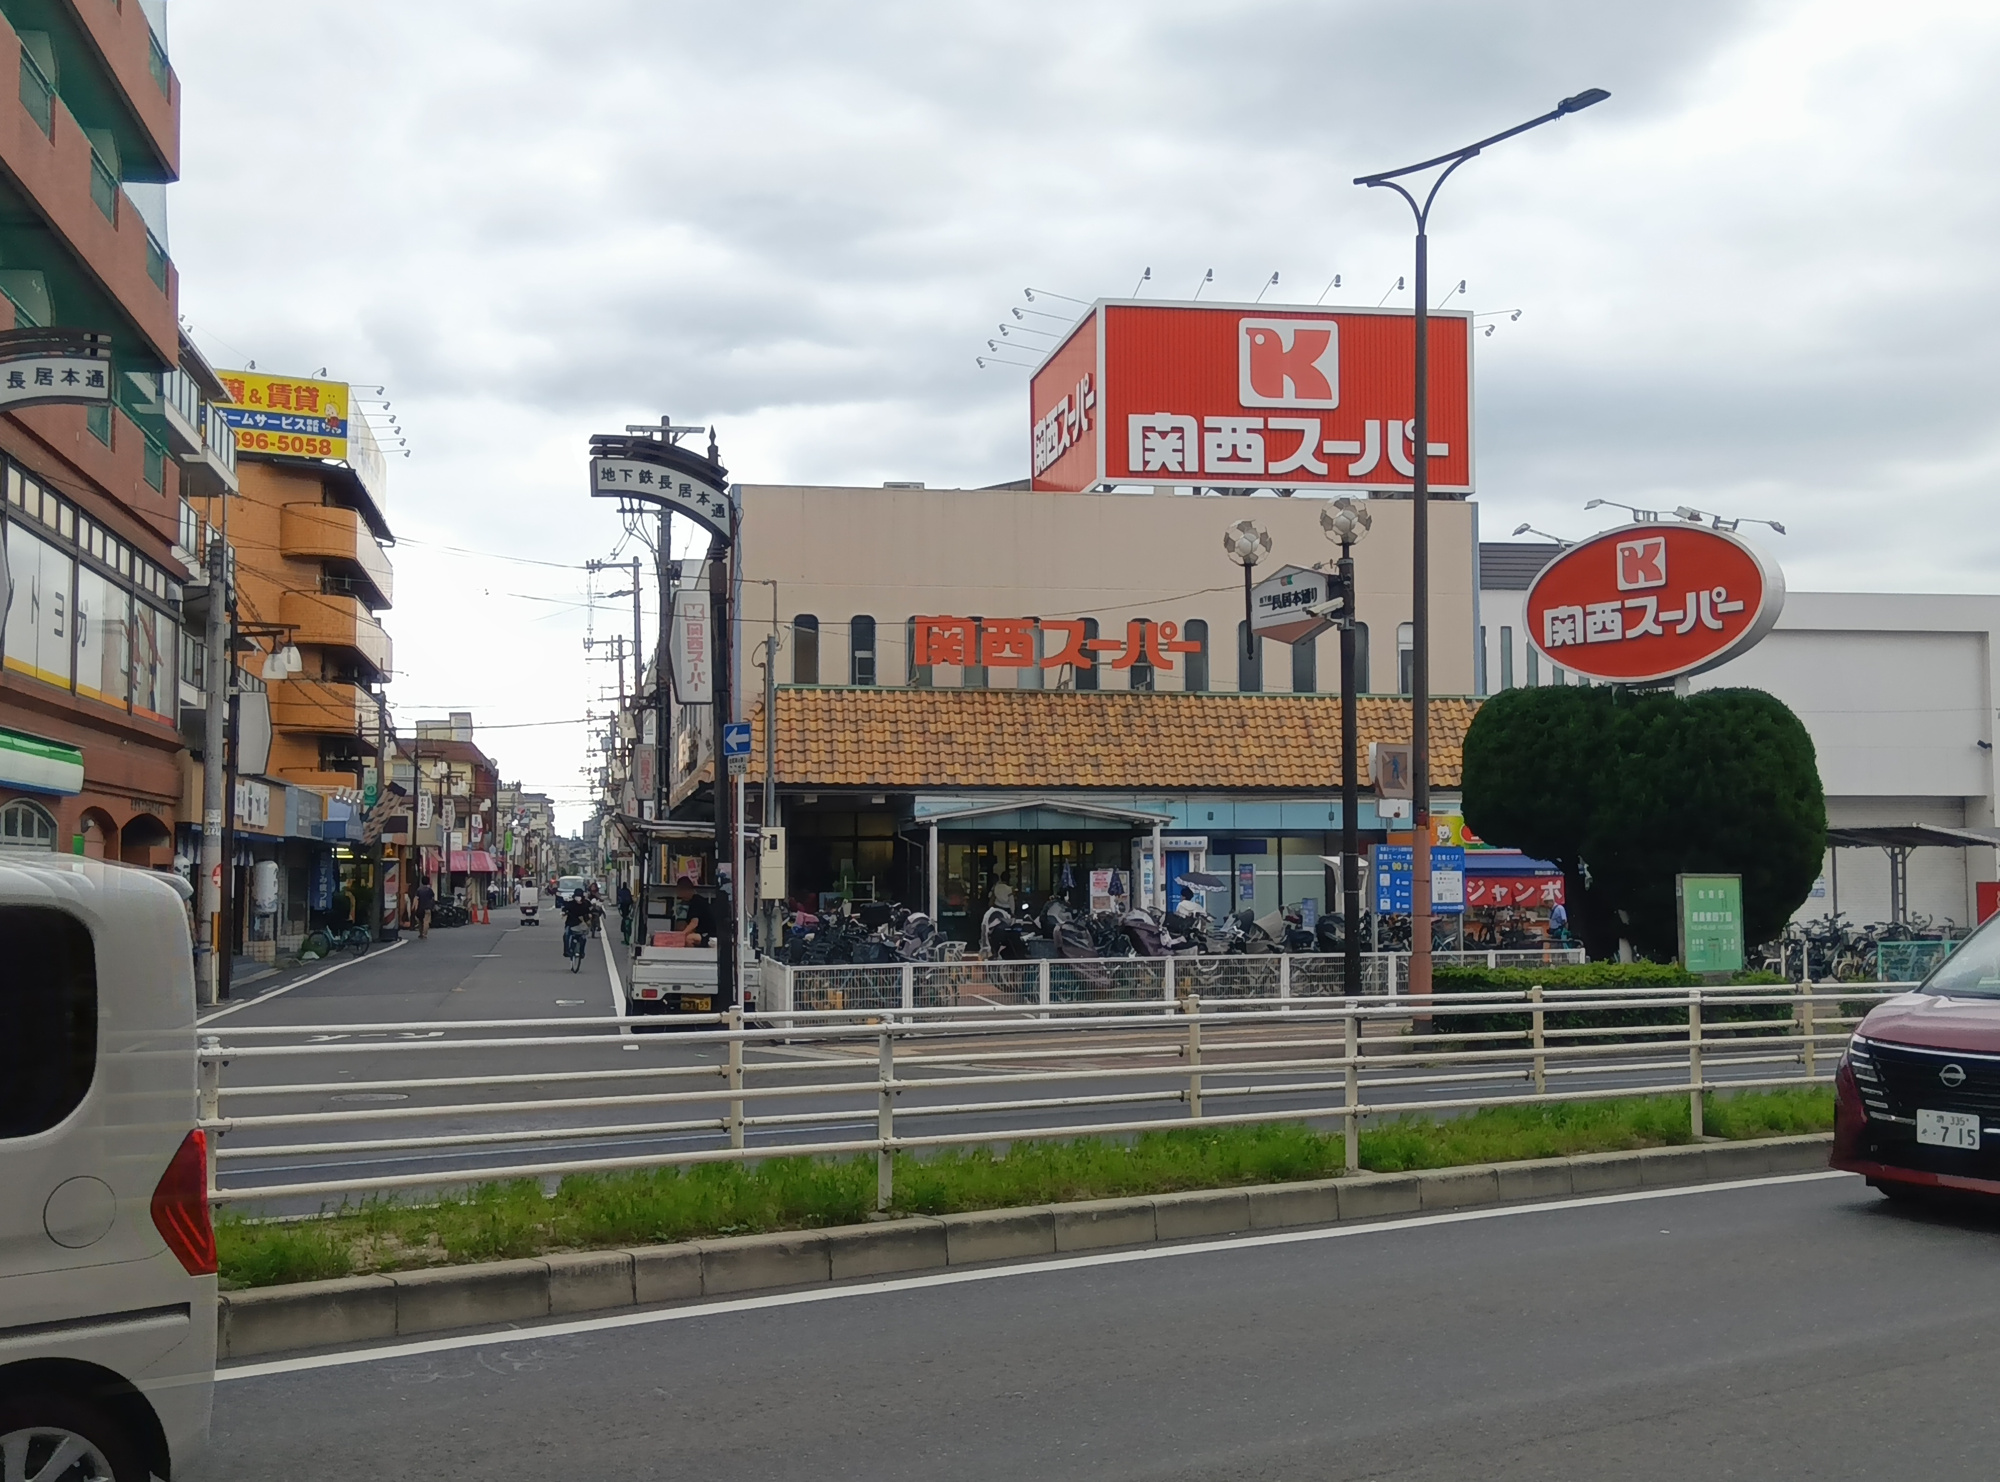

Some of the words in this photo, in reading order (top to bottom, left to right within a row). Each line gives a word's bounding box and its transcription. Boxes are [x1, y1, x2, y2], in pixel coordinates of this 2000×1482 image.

[6, 367, 106, 390] 長居本通
[1033, 372, 1095, 478] 関西スーパー
[1128, 412, 1449, 477] 関西スーパー
[600, 466, 728, 519] 地下鉄長居本通
[1272, 587, 1317, 611] 長居本通り
[1543, 586, 1744, 647] 関西スーパー
[686, 623, 706, 692] 関西スーパー
[914, 614, 1201, 670] 関西スーパー
